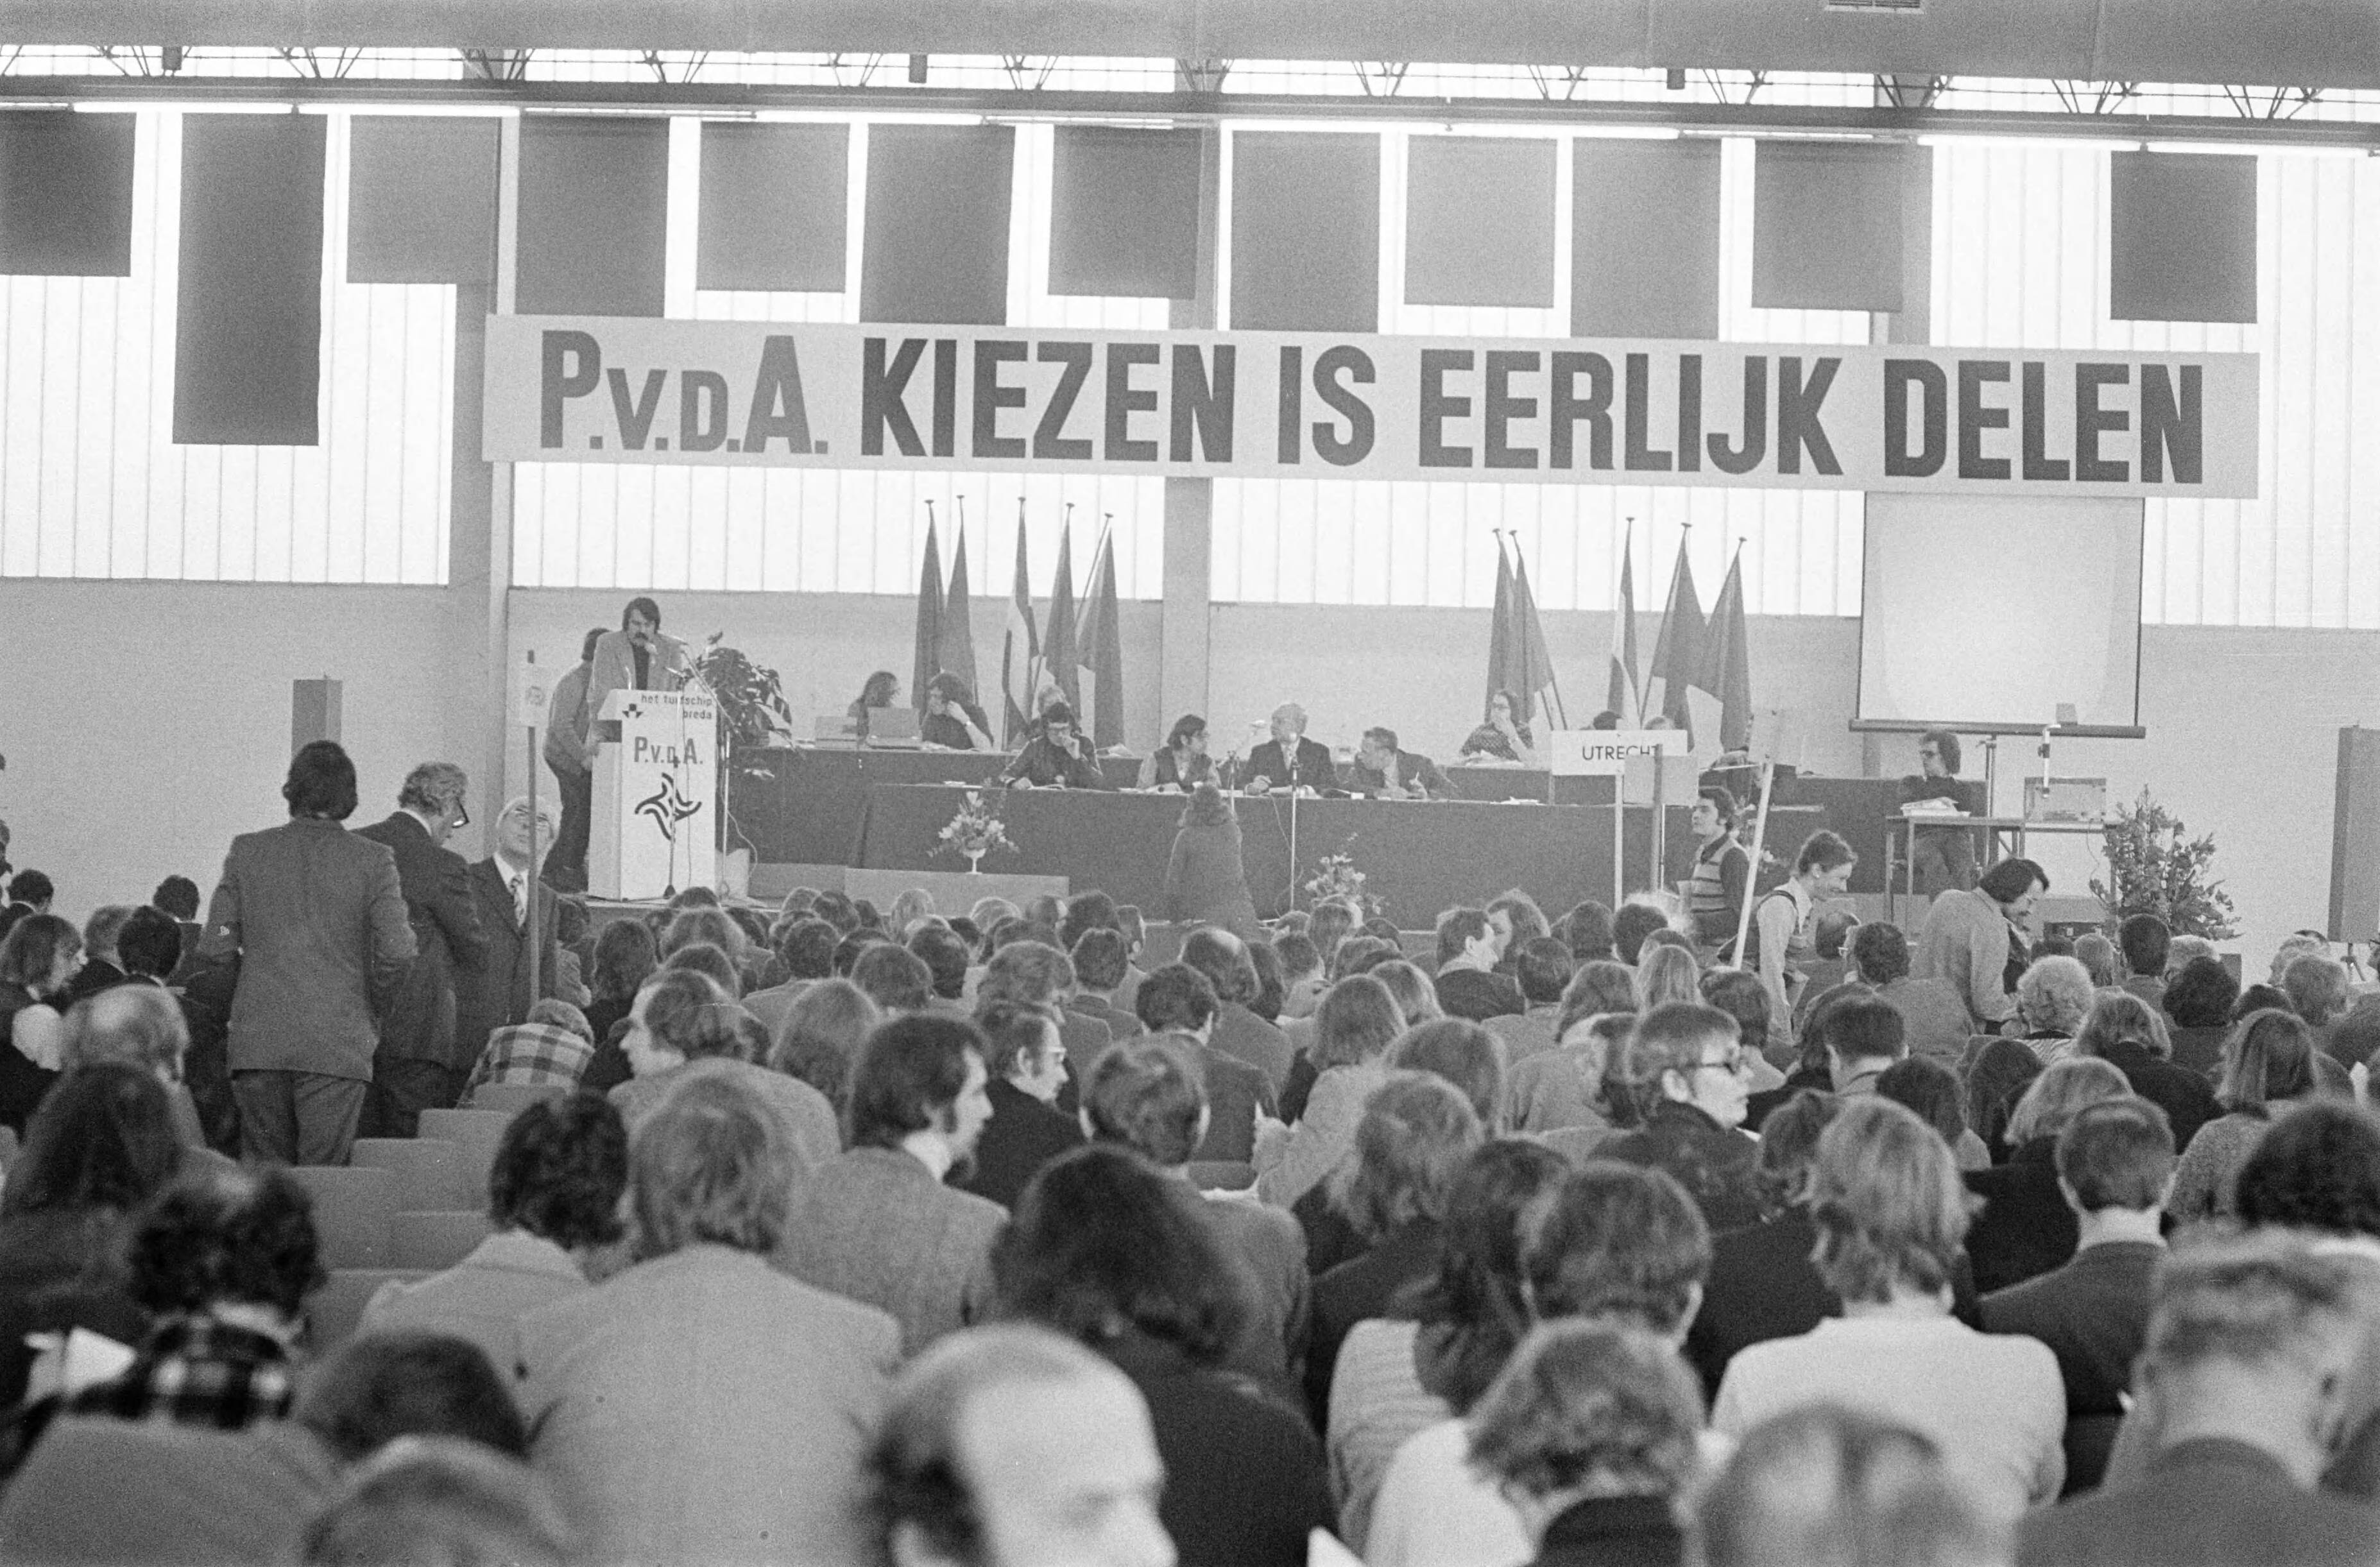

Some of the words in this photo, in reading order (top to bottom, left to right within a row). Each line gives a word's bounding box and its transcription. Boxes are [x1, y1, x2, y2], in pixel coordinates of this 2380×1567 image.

[860, 337, 1237, 463] KIEZEN
[1278, 345, 1376, 467] IS
[1419, 348, 1844, 476] EERLIJK
[1883, 358, 2204, 484] DELEN
[642, 694, 658, 704] het
